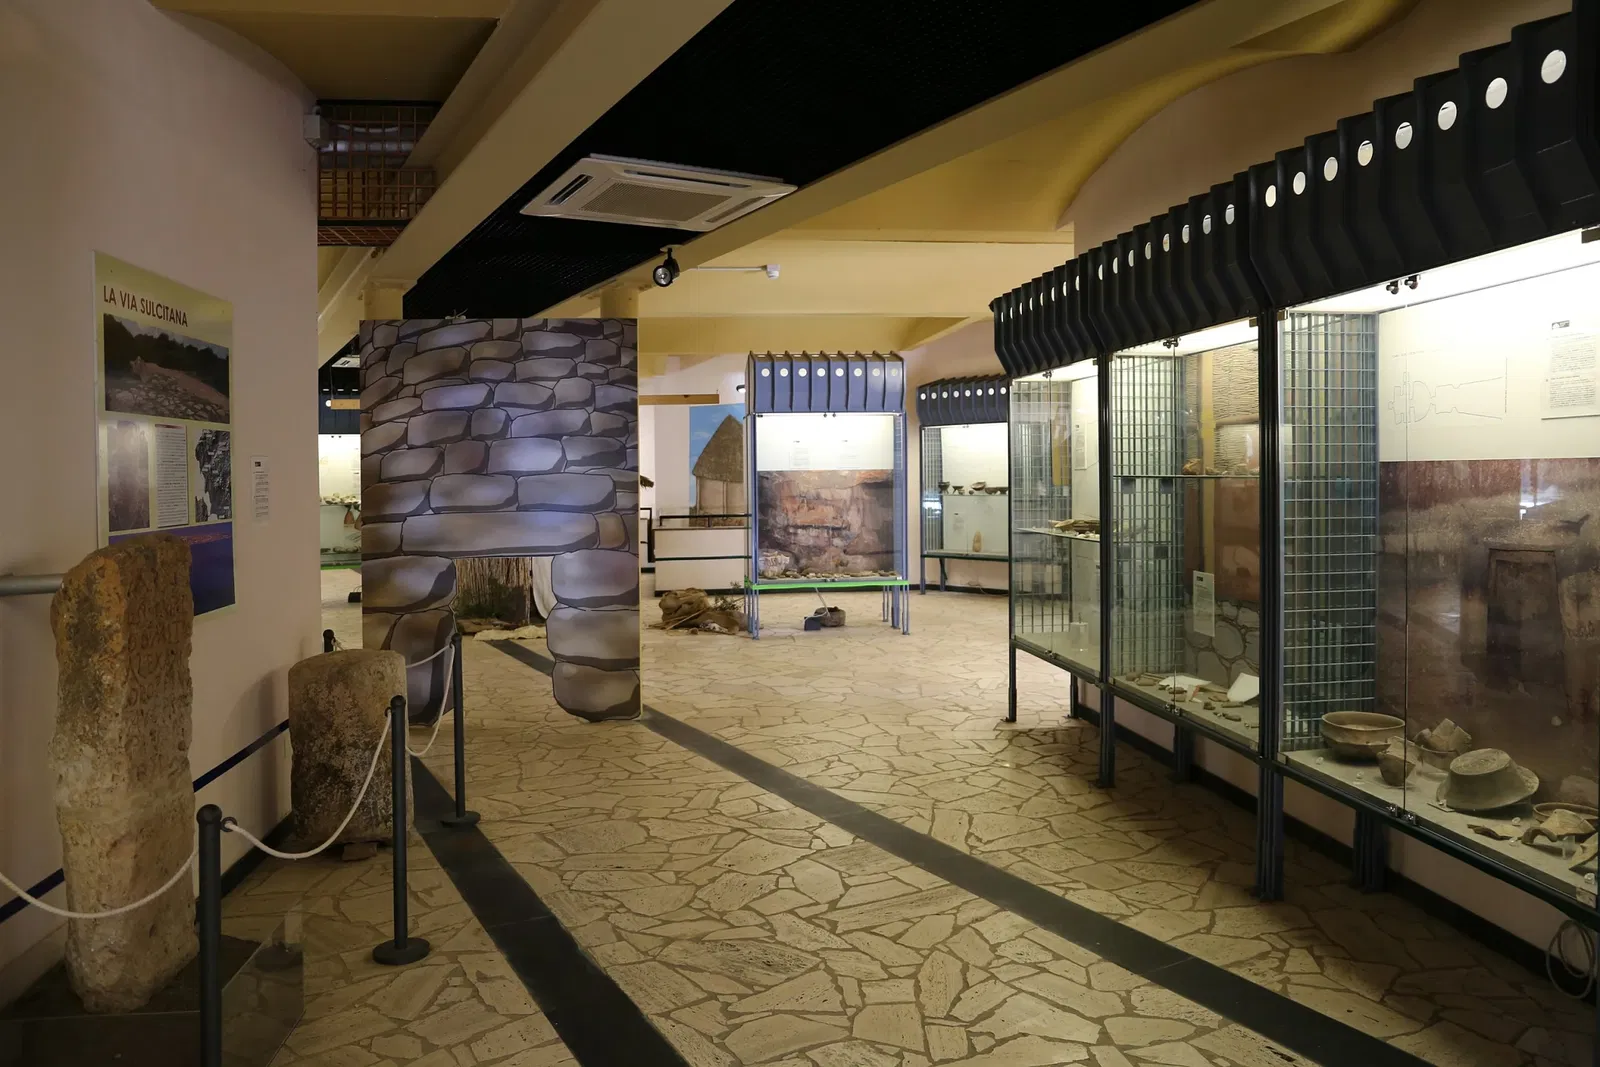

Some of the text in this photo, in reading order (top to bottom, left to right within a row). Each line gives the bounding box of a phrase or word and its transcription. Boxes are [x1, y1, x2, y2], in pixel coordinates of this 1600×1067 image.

[104, 285, 188, 327] LA VIA SULCITANA
